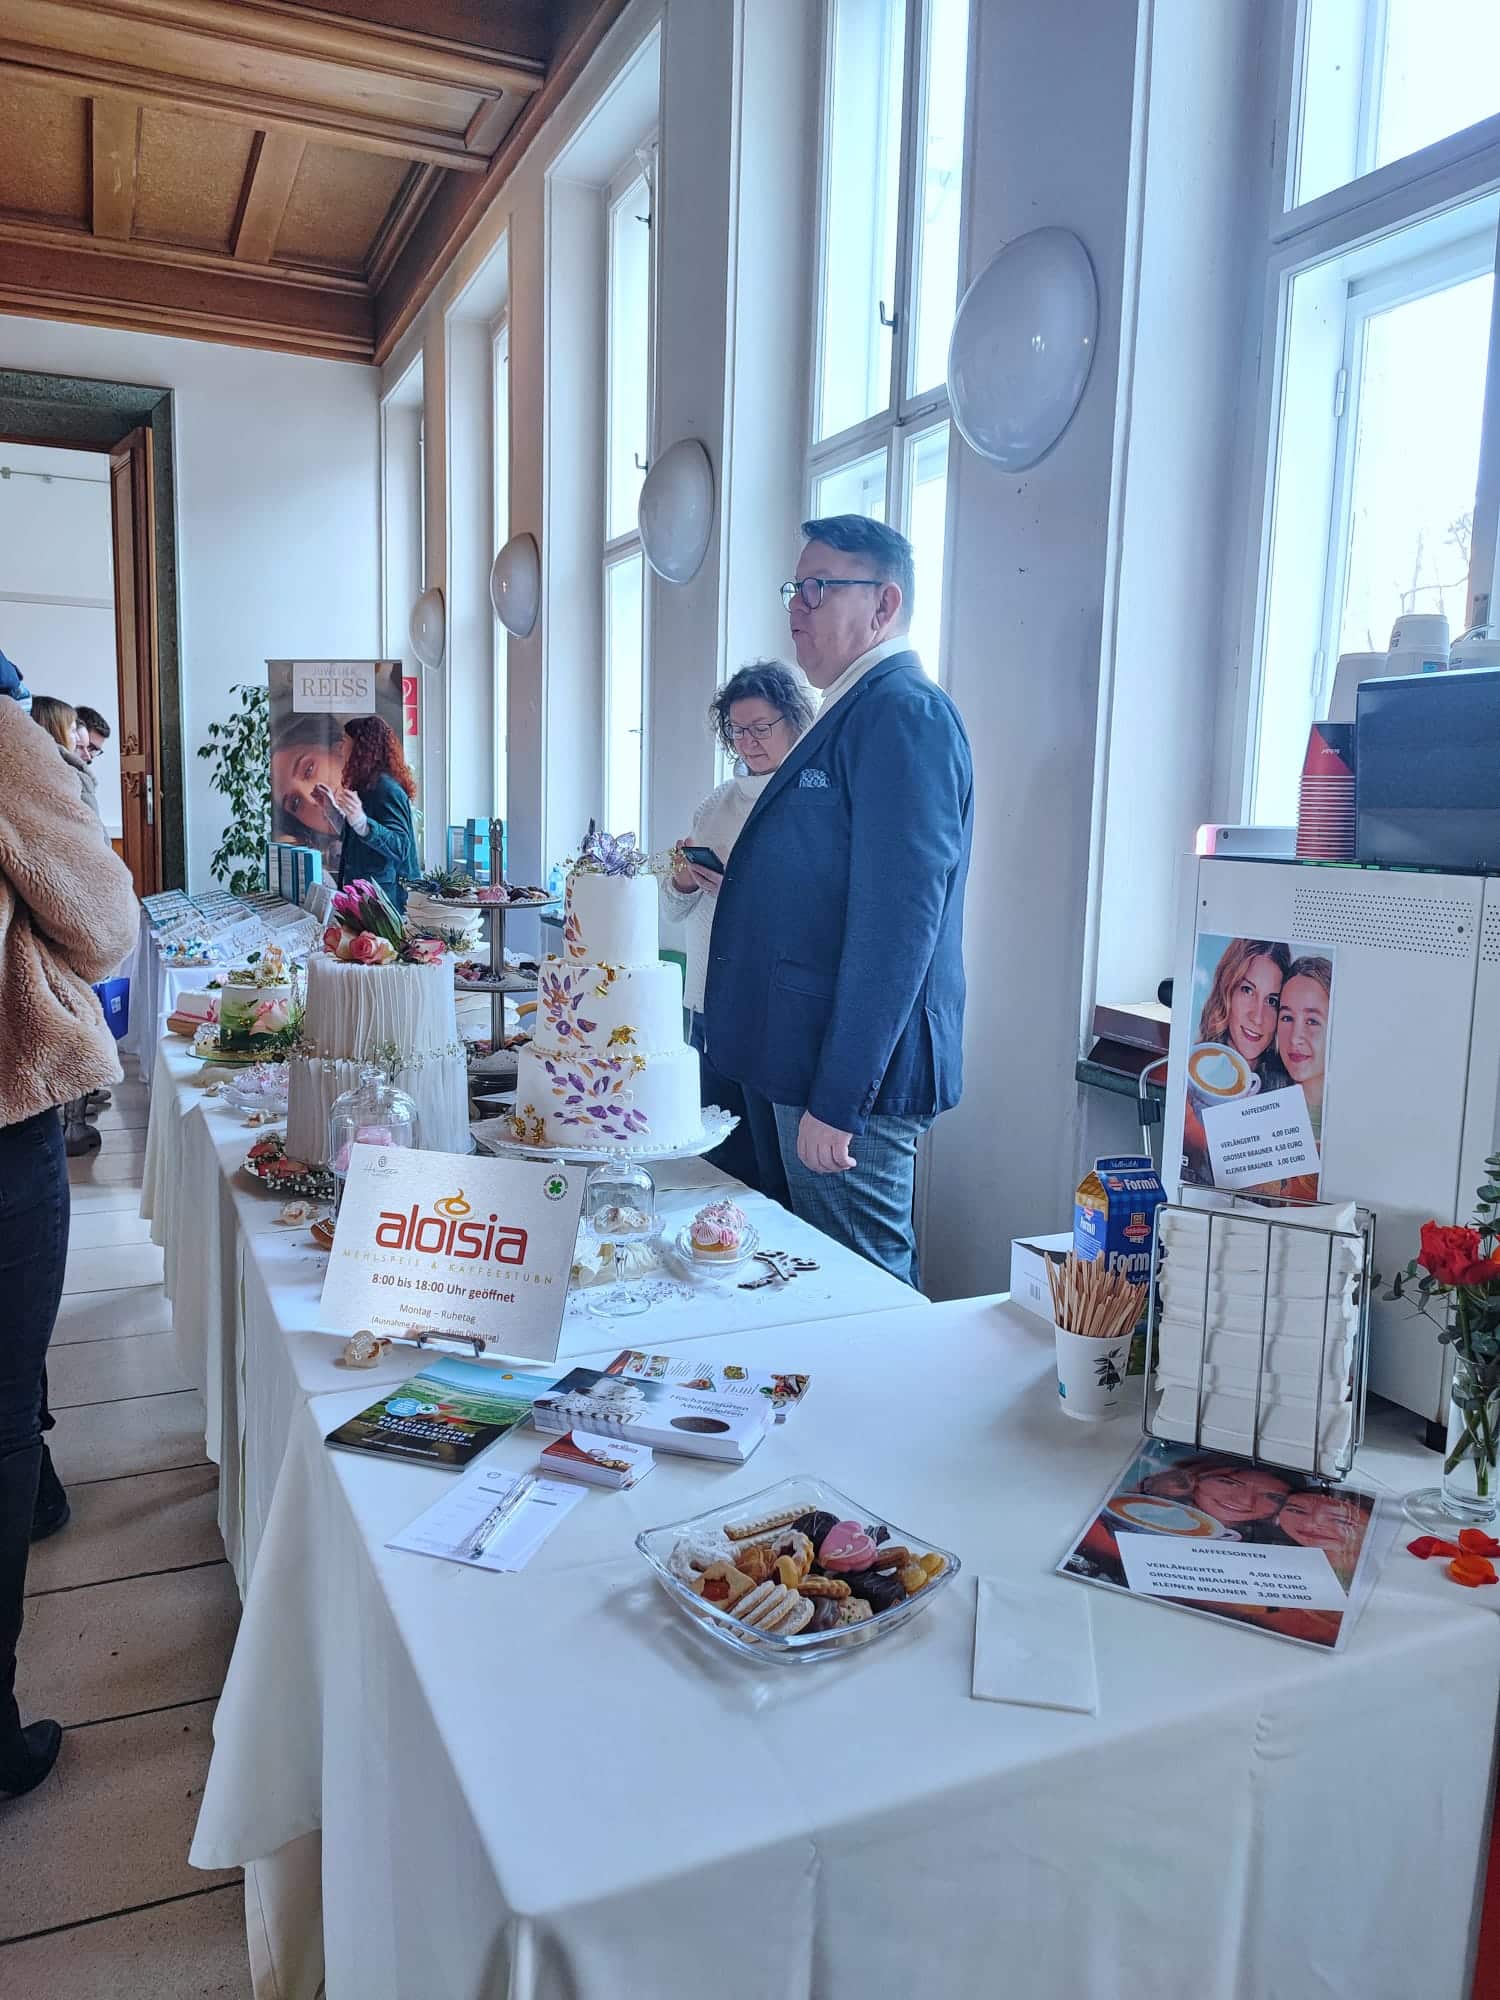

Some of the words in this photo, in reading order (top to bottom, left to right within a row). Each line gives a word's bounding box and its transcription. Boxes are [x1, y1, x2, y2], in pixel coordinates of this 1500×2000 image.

[301, 678, 368, 697] REISS
[1284, 1126, 1300, 1136] EURO
[1287, 1140, 1304, 1149] EURO
[1289, 1153, 1306, 1163] EURO
[1124, 1178, 1159, 1191] Formil
[376, 1204, 528, 1265] aloisia
[372, 1273, 395, 1286] 8:00
[397, 1276, 412, 1288] bis
[415, 1279, 444, 1293] 18:00
[447, 1283, 466, 1296] Uhr
[468, 1287, 516, 1303] geöffnet
[399, 1304, 432, 1318] Montag
[441, 1310, 477, 1325] Ruhetag
[1191, 1547, 1267, 1560] KAFFEESORTEN
[1146, 1561, 1225, 1574] VERLÄNGERTER
[1249, 1571, 1270, 1579] 4,00
[1273, 1573, 1302, 1581] EURO
[1149, 1571, 1196, 1581] GROSSER
[1198, 1576, 1249, 1586] BRAUNER
[1253, 1581, 1276, 1589] 4,50
[1278, 1583, 1308, 1591] EURO
[1152, 1581, 1195, 1591] KLEINER
[1196, 1585, 1248, 1596] BRAUNER
[1257, 1590, 1281, 1599] 3,00
[1282, 1593, 1312, 1601] EURO
